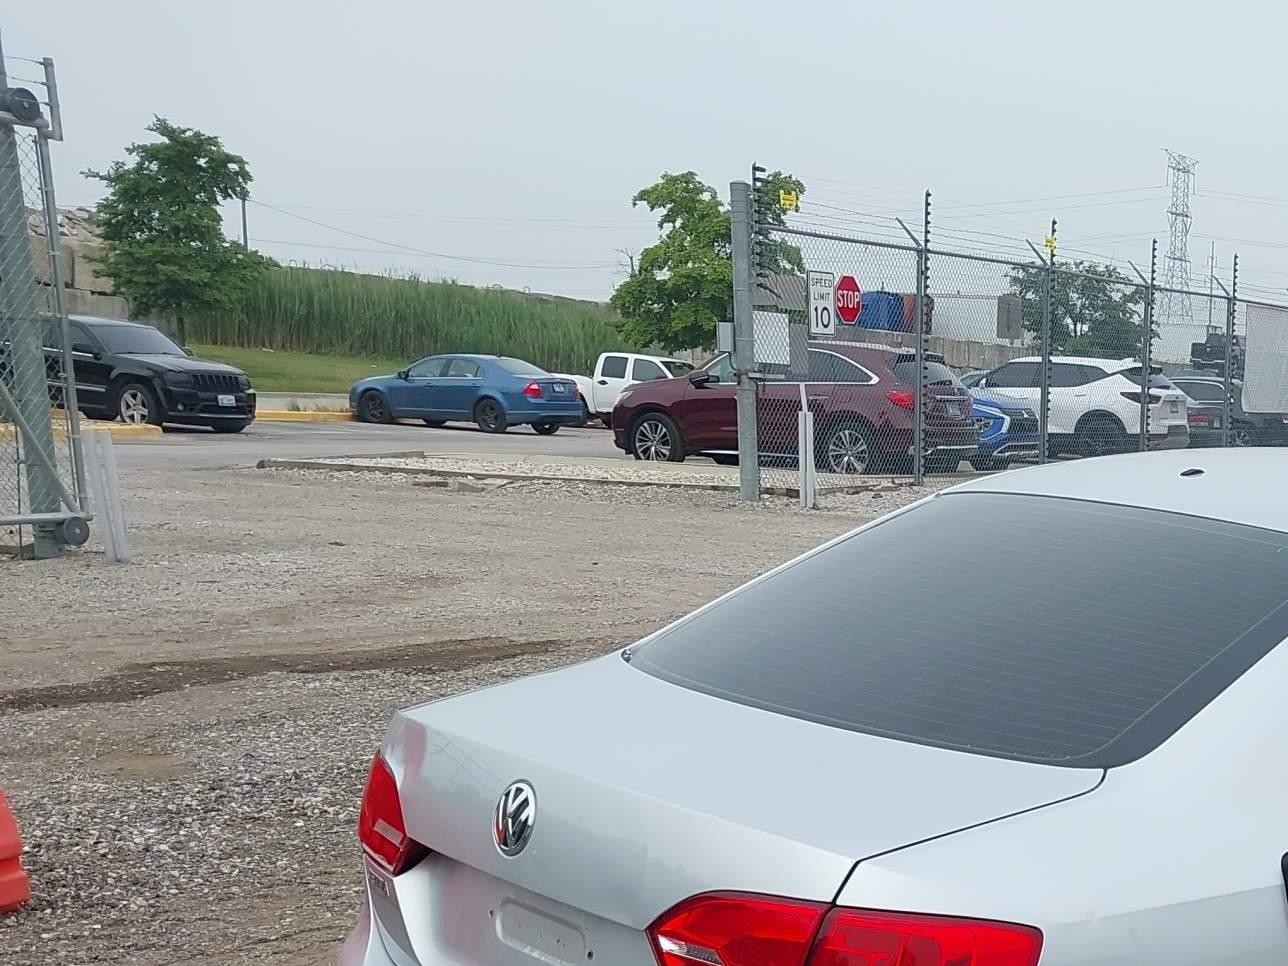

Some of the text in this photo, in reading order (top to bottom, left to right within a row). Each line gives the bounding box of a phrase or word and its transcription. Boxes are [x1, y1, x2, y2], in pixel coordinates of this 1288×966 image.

[811, 278, 833, 289] SPEED
[813, 291, 831, 302] LIMIT
[837, 290, 860, 309] STOP
[814, 305, 831, 329] 10
